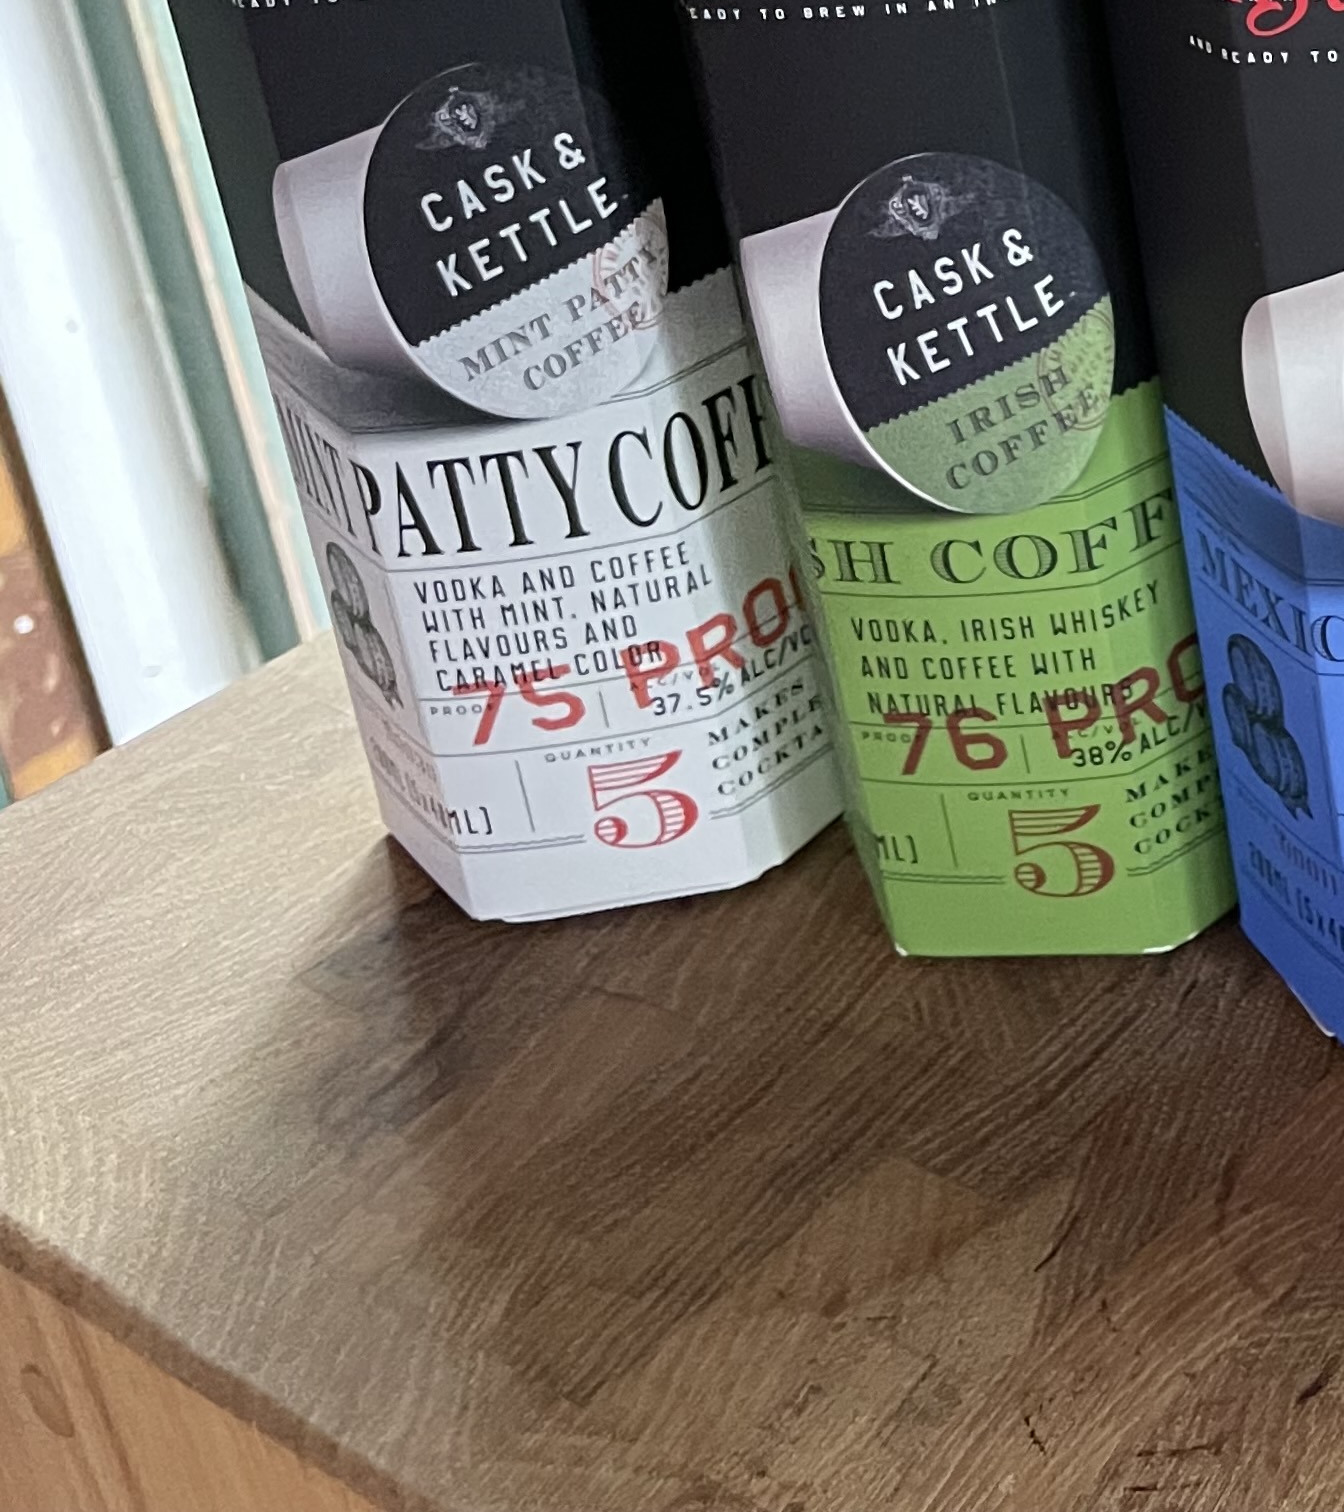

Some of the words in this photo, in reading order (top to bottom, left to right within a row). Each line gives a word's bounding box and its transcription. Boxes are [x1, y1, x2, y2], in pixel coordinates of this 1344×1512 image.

[803, 4, 866, 19] BREW
[420, 148, 547, 232] CASK
[553, 131, 587, 171] &
[436, 176, 619, 297] KETTLE
[872, 242, 994, 320] CASK
[1001, 227, 1035, 268] &
[456, 313, 551, 382] MINT
[521, 301, 645, 391] COFFEE
[885, 274, 1065, 386] KETTLE
[945, 365, 1072, 447] IRISH
[348, 441, 583, 558] PATTY
[413, 576, 505, 606] VODKA
[521, 562, 576, 592] AND
[590, 540, 690, 584] COFFEE
[423, 604, 486, 636] WITH
[590, 563, 713, 611] NATURAL
[429, 627, 568, 663] FLAVOURS
[584, 614, 639, 647] AND
[960, 615, 1036, 643] IRISH
[1050, 579, 1161, 636] WHISKEY
[436, 657, 557, 692] CARAMEL
[574, 638, 663, 676] COLOR
[650, 671, 735, 716] 37.5%
[861, 655, 909, 681] AND
[922, 651, 1017, 680] COFFEE
[1033, 647, 1096, 676] WITH
[452, 664, 587, 747] 75
[867, 691, 981, 719] NATURAL
[543, 736, 653, 763] QUANTITY
[882, 707, 1008, 777] 76
[1071, 740, 1132, 768] 38%
[586, 749, 700, 849] 5
[967, 788, 1071, 802] QUANTITY
[1007, 803, 1116, 898] 5
